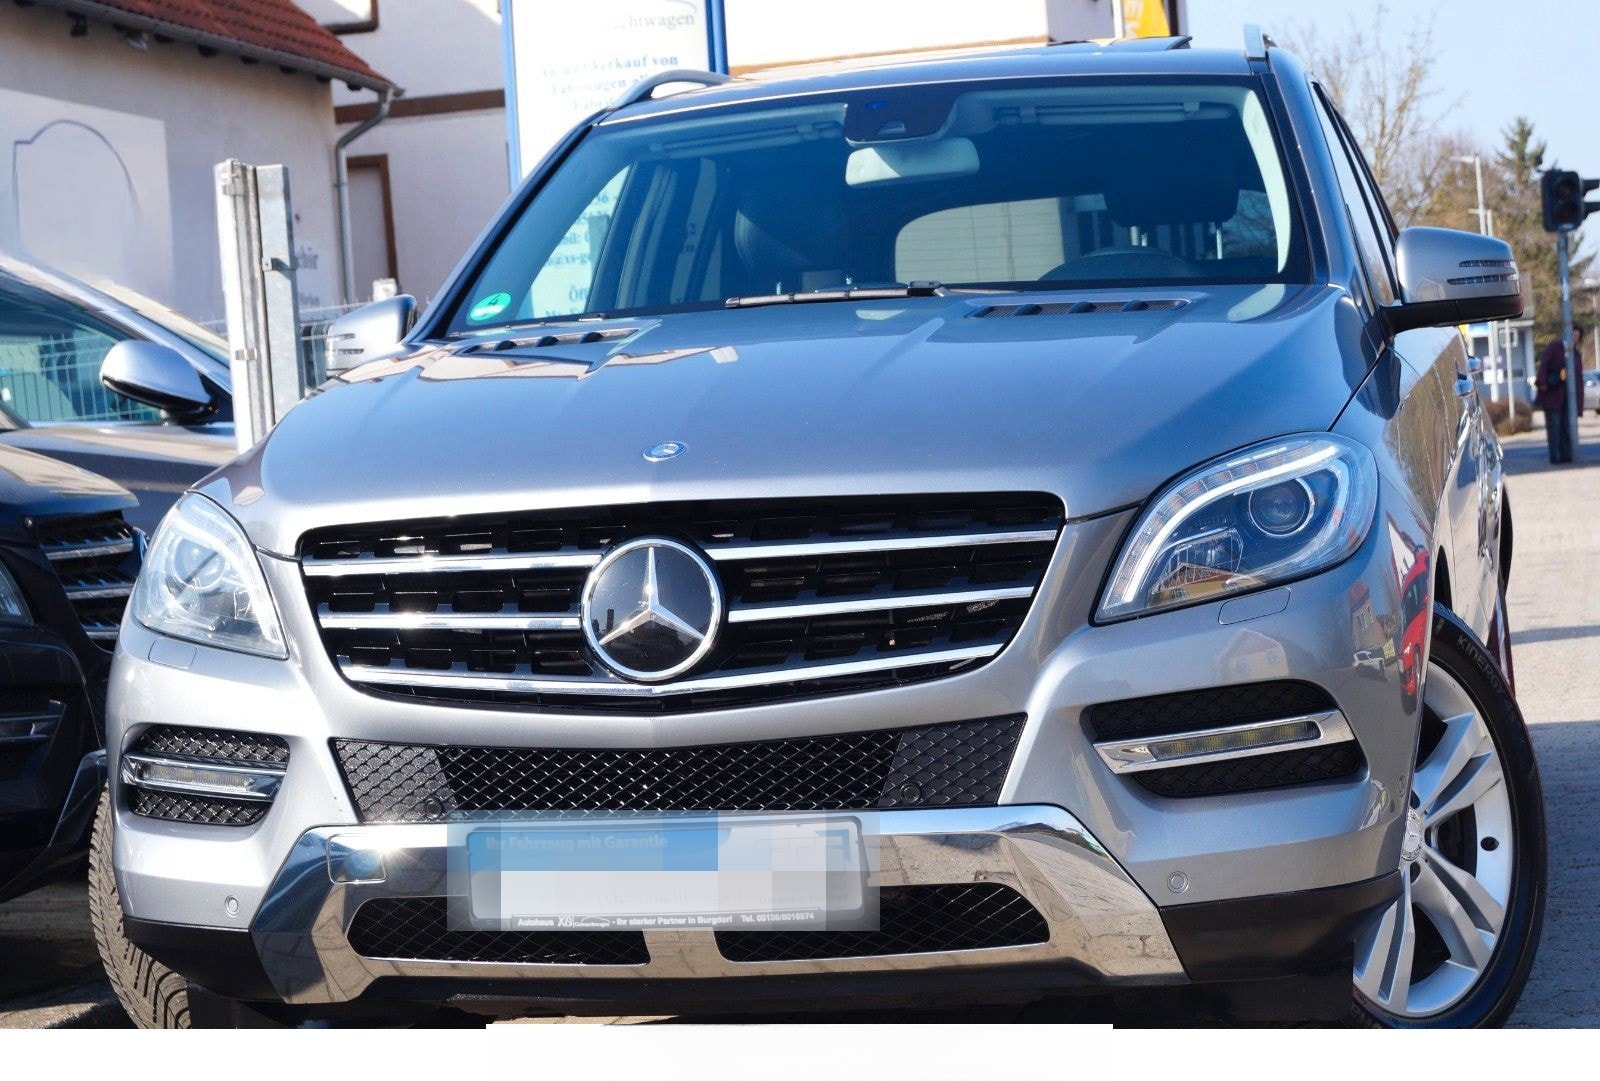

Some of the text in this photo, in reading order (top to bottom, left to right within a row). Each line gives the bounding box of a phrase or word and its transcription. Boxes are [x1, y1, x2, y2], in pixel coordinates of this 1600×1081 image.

[652, 55, 679, 67] von
[486, 833, 669, 853] Ihr Fahrzeug mit Garantie
[517, 917, 555, 927] Autohaus
[616, 917, 628, 926] Ihr
[628, 917, 657, 926] starker
[658, 915, 687, 926] Partner
[688, 915, 697, 925] in
[697, 914, 733, 925] Burgdorf
[740, 914, 755, 923] Tel.
